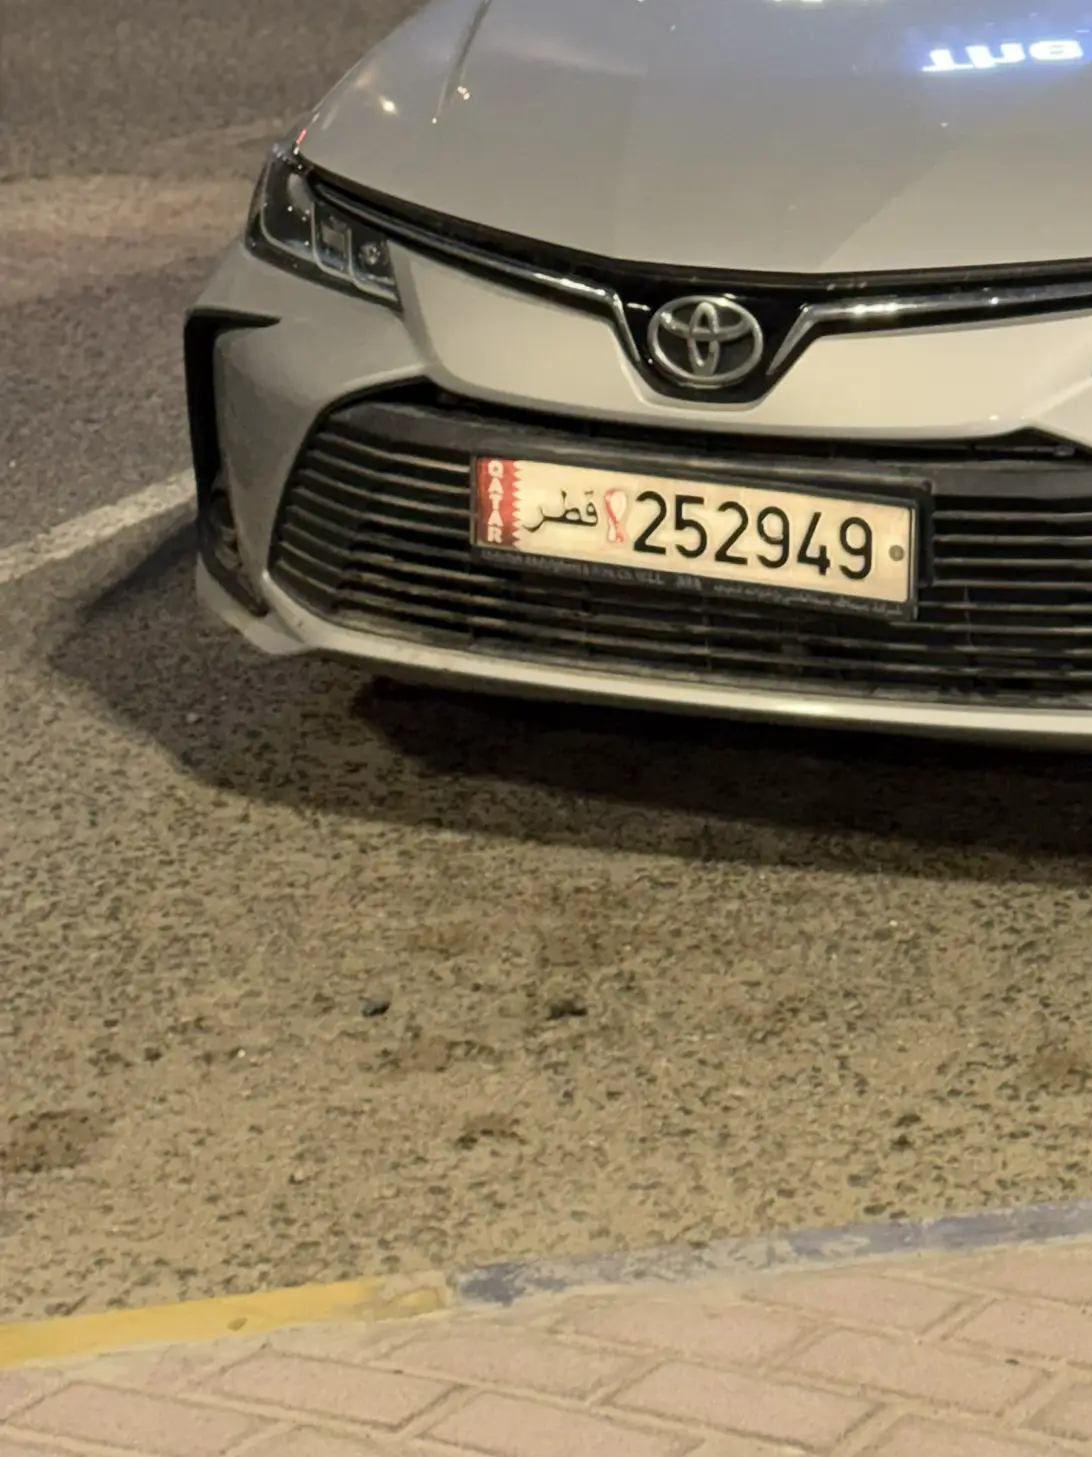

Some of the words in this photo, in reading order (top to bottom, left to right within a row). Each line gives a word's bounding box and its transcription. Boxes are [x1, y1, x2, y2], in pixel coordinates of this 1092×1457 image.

[487, 459, 505, 544] QATAR
[520, 489, 600, 534] قطر
[632, 490, 874, 581] 252949
